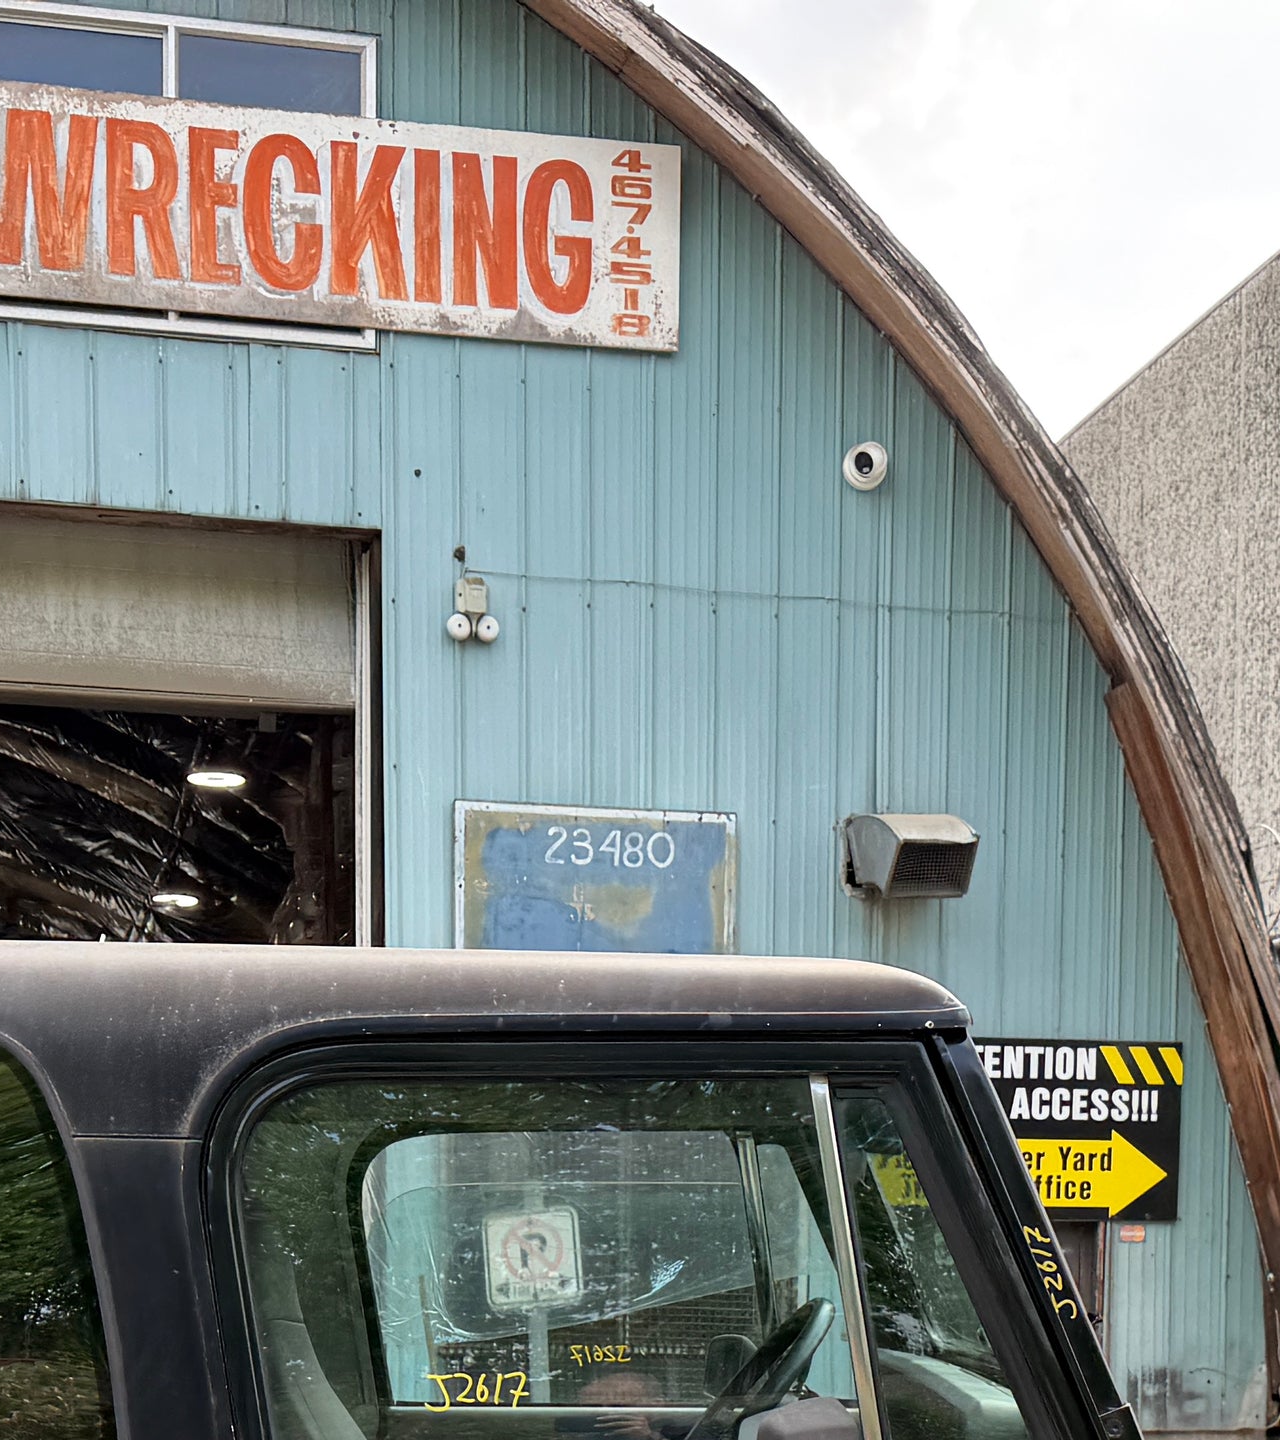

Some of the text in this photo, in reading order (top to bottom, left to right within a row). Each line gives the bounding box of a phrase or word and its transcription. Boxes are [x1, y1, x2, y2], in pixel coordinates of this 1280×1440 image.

[544, 825, 676, 869] 23480
[1009, 1087, 1159, 1122] ACCESS!!!
[1057, 1146, 1113, 1172] Yard
[1033, 1174, 1092, 1200] ffice
[1023, 1225, 1077, 1319] J2617
[424, 1371, 530, 1413] J2617
